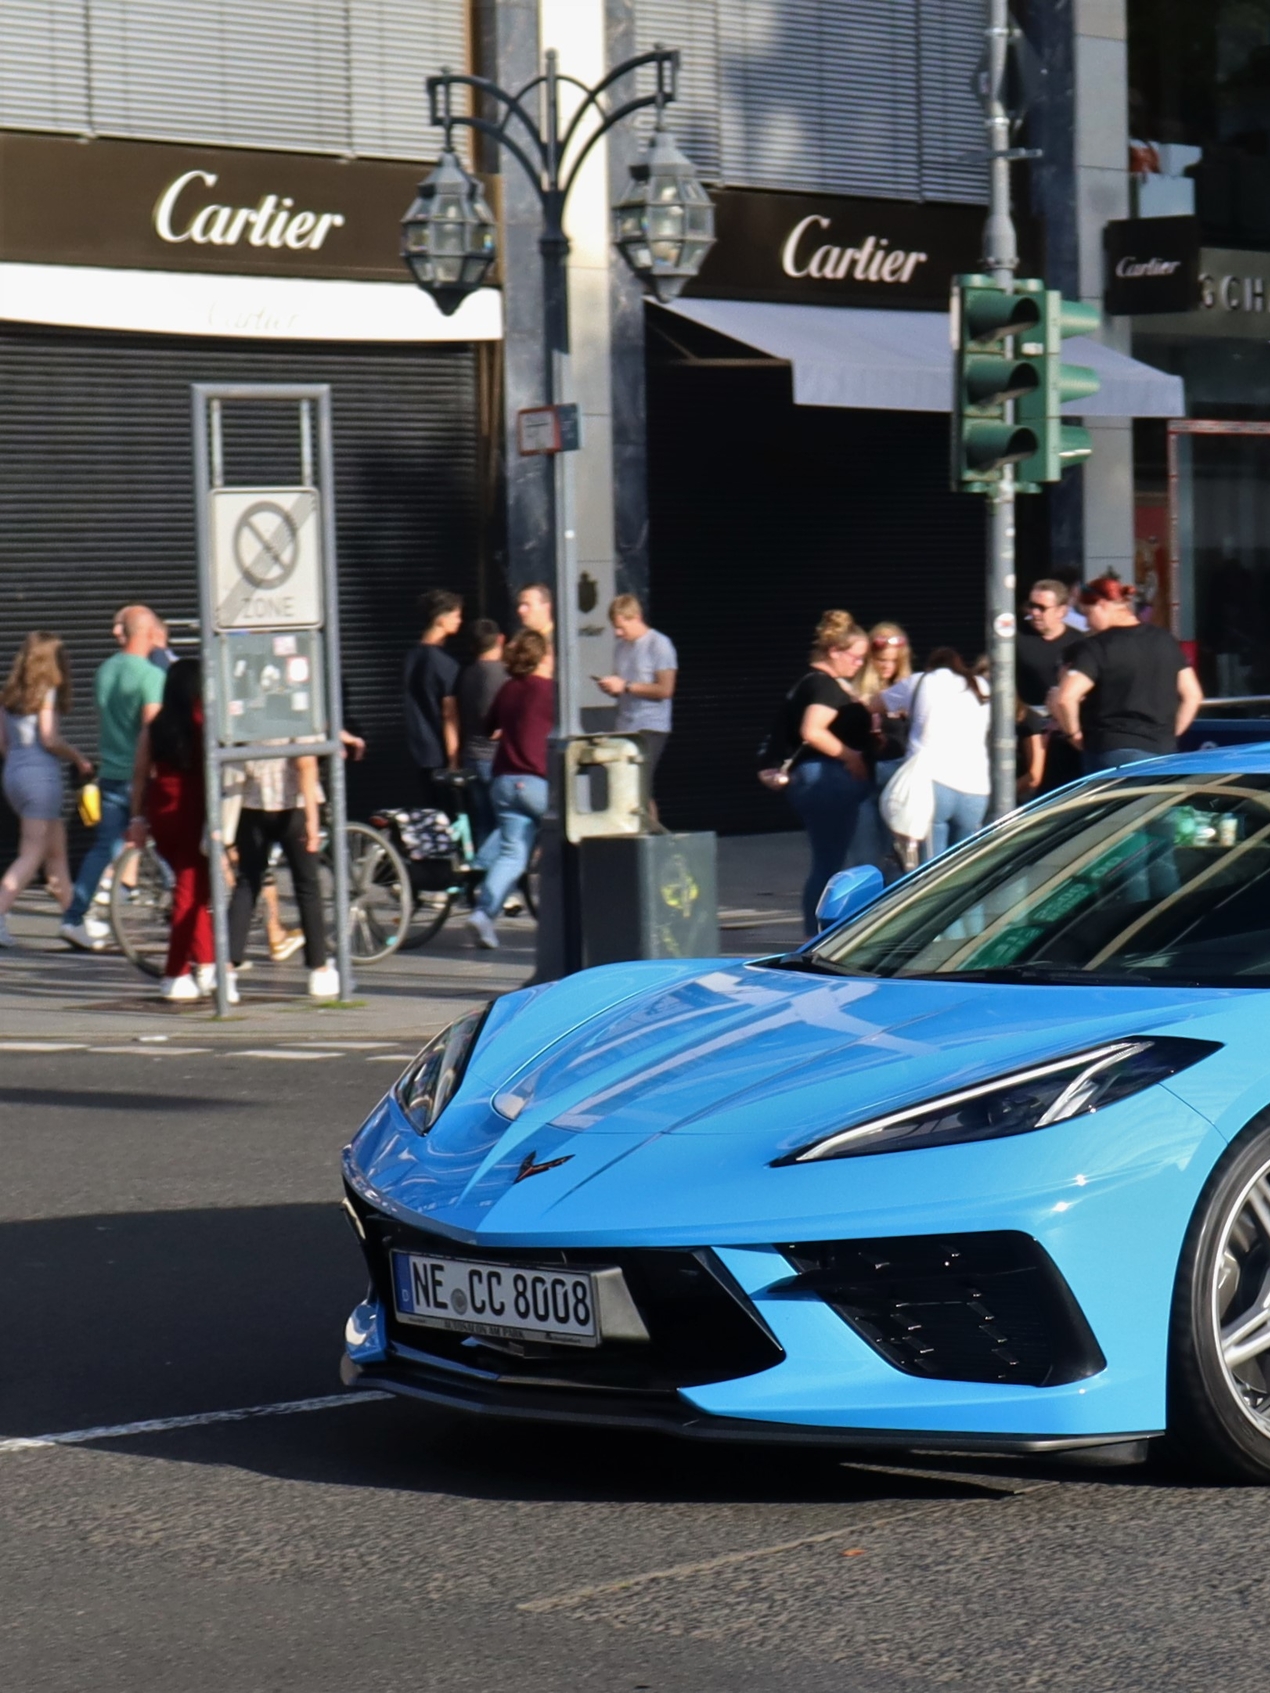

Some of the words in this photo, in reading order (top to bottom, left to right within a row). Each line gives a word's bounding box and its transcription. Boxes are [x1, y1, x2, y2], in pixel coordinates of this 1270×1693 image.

[155, 169, 345, 250] Cartier
[782, 214, 928, 283] Cartier
[1115, 256, 1181, 278] Cartier
[243, 596, 295, 619] ZONE
[412, 1261, 448, 1309] NE
[468, 1269, 505, 1316] CC
[513, 1273, 590, 1327] 8008
